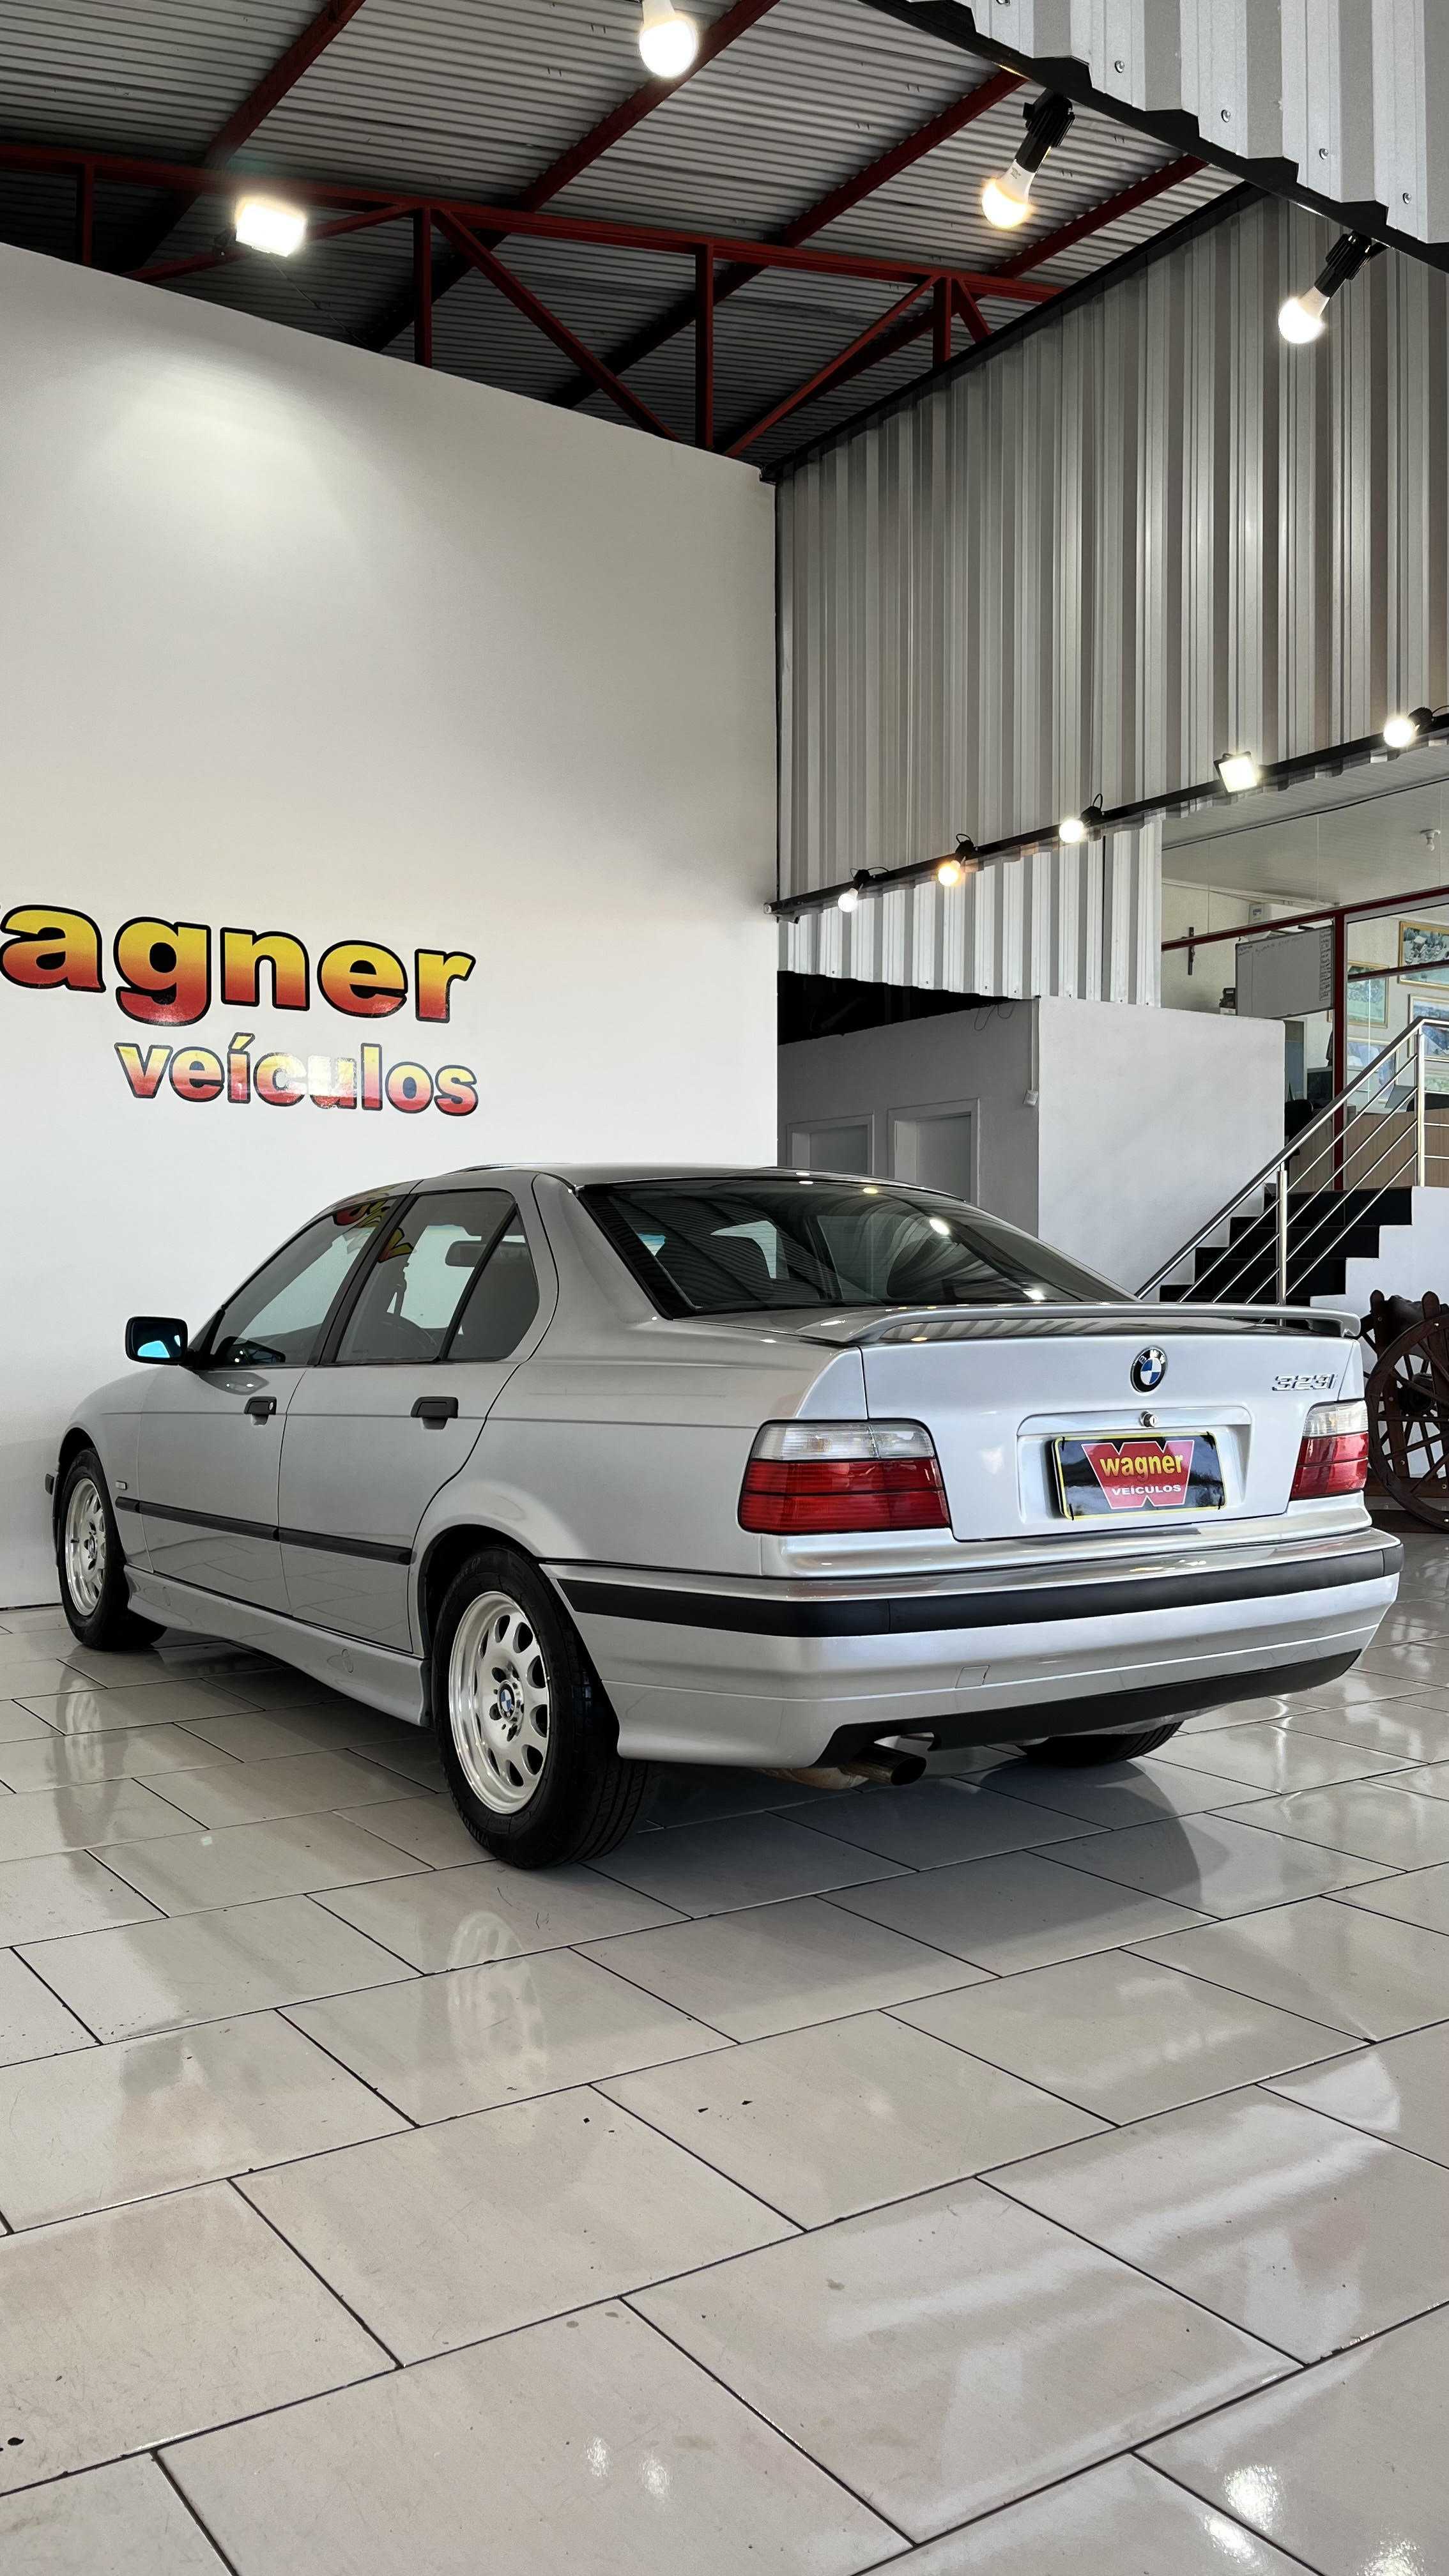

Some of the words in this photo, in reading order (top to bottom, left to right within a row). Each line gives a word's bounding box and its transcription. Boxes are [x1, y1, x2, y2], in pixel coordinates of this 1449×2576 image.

[114, 1032, 479, 1117] veículos
[1100, 1454, 1184, 1482] wagner
[1112, 1484, 1182, 1496] VEÍCULOS
